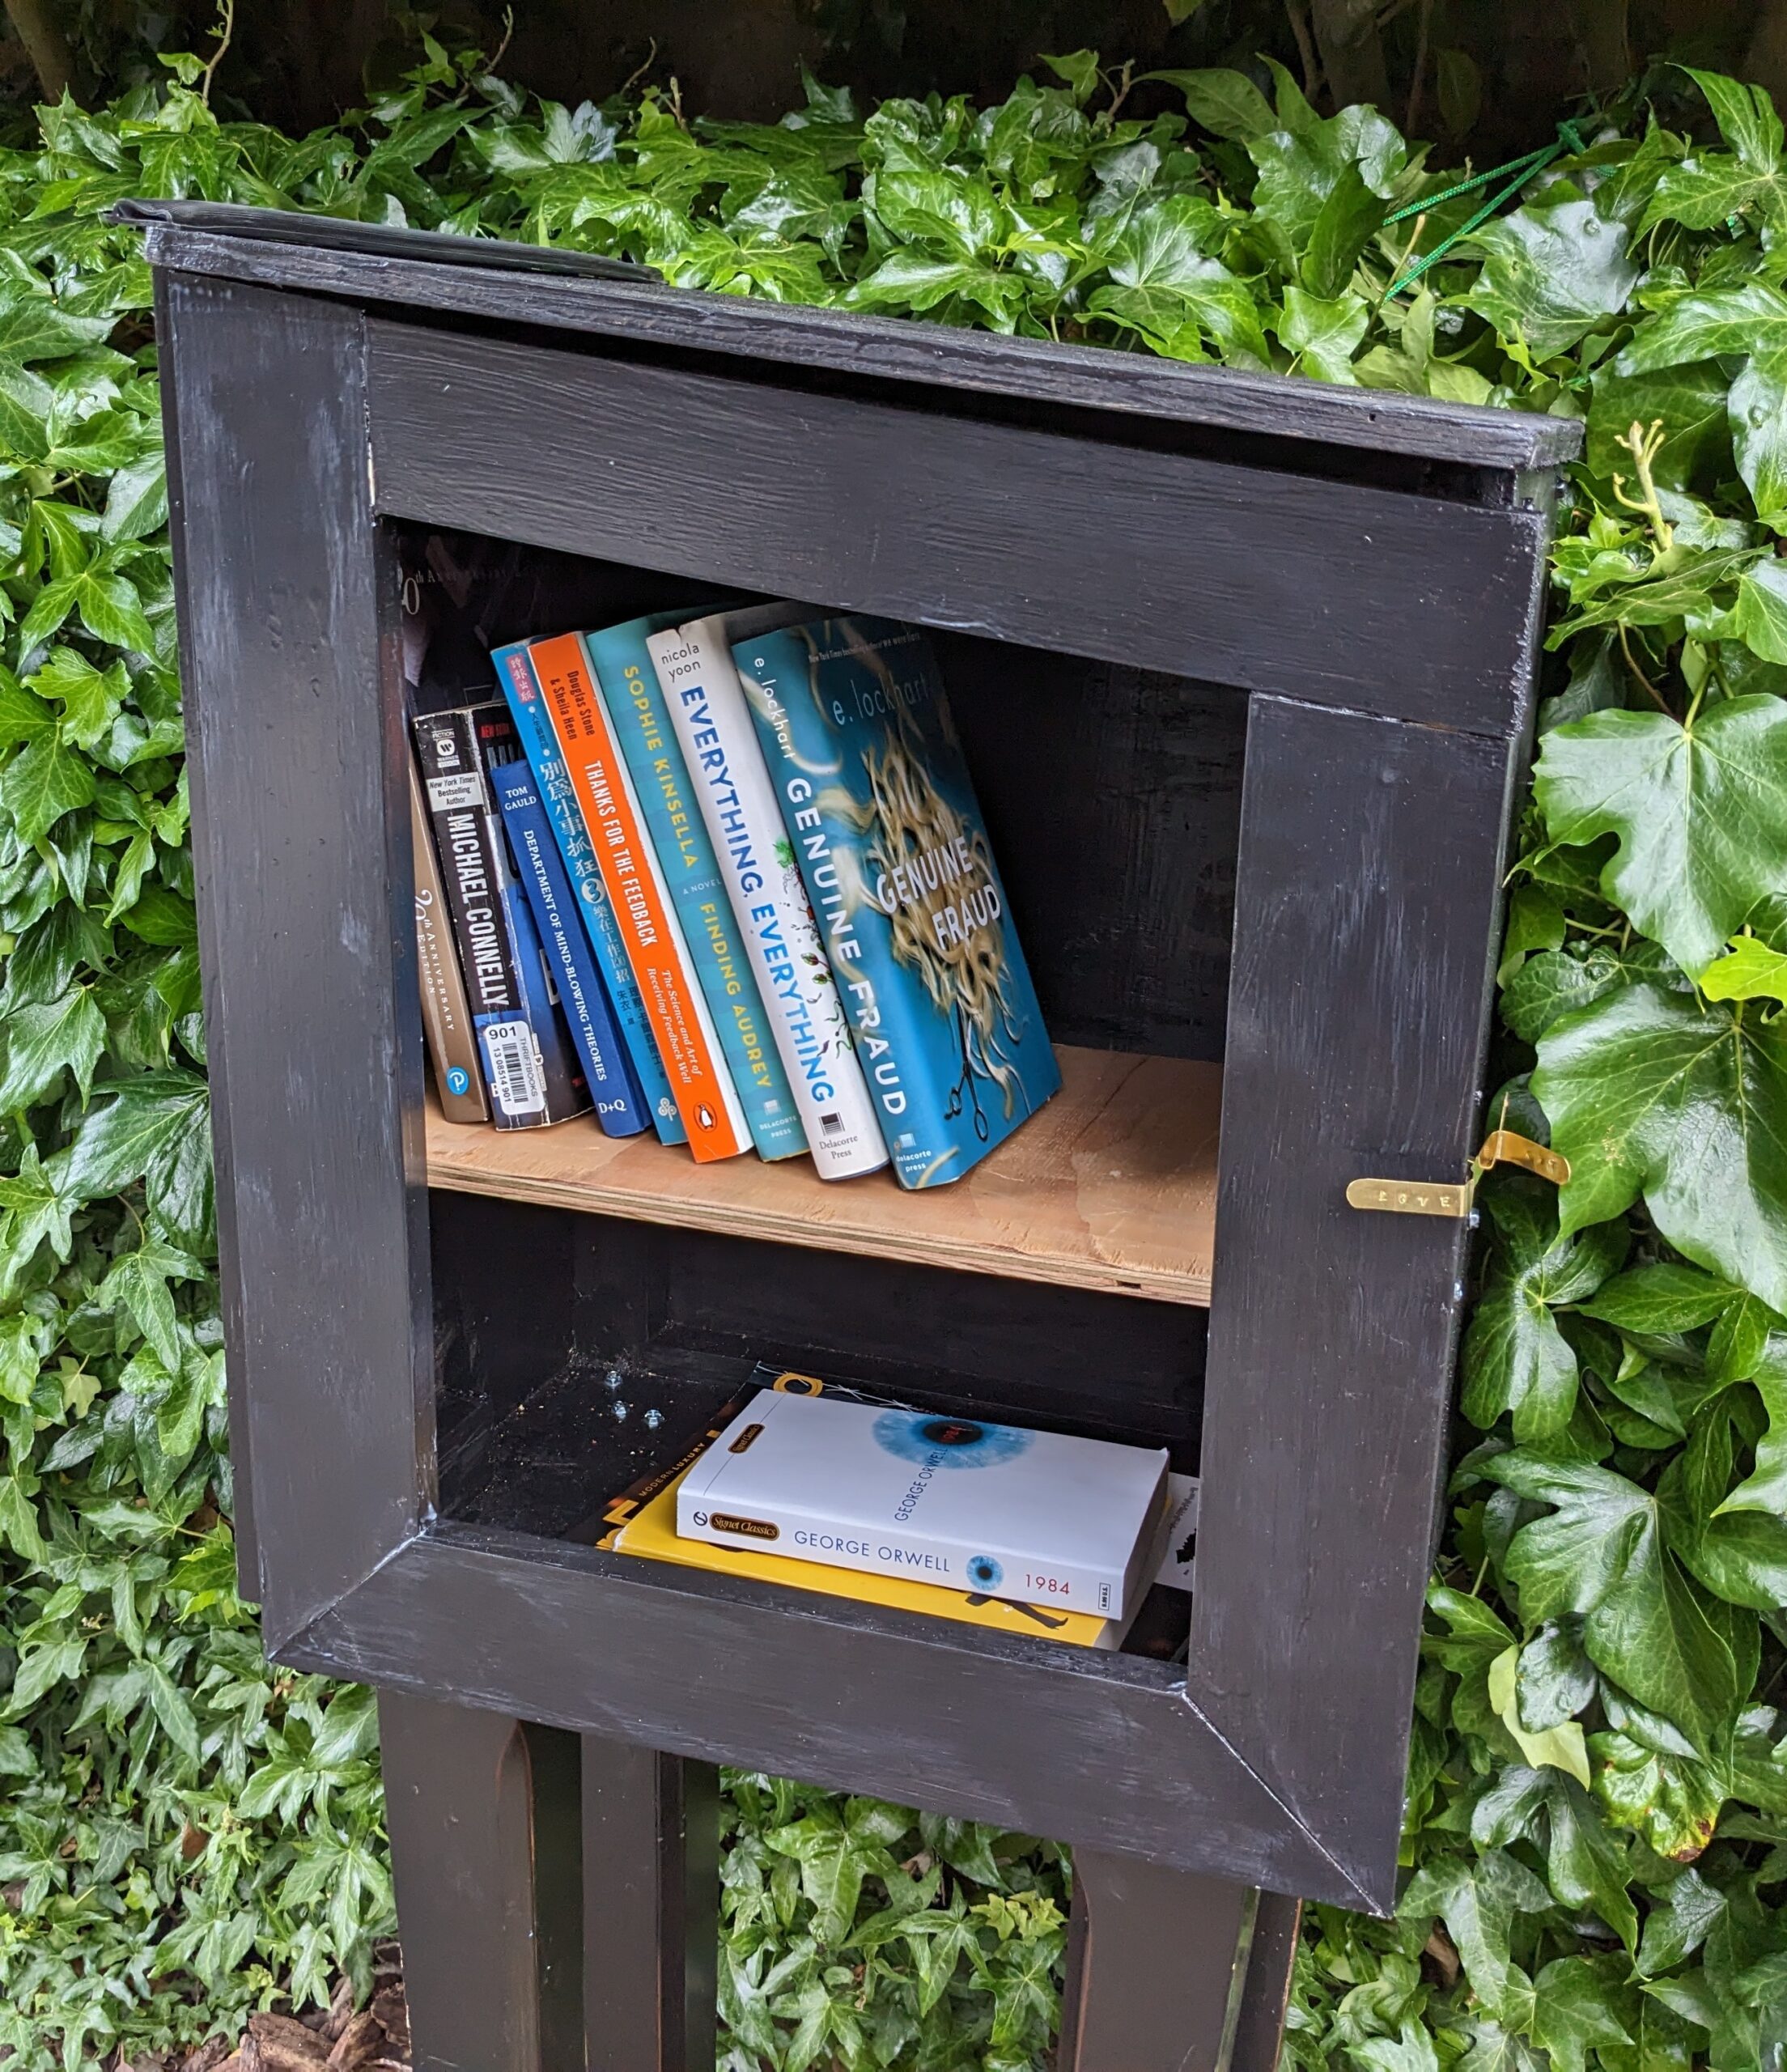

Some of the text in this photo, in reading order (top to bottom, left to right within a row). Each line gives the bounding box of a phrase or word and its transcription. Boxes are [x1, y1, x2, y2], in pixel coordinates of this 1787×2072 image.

[660, 643, 700, 666] nicola
[669, 659, 702, 683] yoon
[550, 677, 578, 741] & Sheila Heen
[567, 670, 596, 737] Douglas Stone
[850, 672, 929, 720] lockhart
[432, 731, 455, 740] FICTION
[761, 679, 796, 760] lockhart
[430, 775, 476, 789] New York Times
[624, 666, 699, 868] SOPHIE KINSELLA
[438, 786, 472, 798] Bestselling
[446, 796, 466, 805] Author
[504, 796, 537, 811] GAULD
[505, 786, 528, 799] TOM
[584, 760, 659, 948] THANKS FOR THE FEEDBACK
[876, 836, 974, 915] GENUINE
[690, 877, 723, 893] NOVEL
[415, 889, 433, 928] 20th
[447, 813, 510, 1007] MICHAEL CONNELLY
[932, 884, 1001, 950] FRAUD
[417, 934, 435, 995] EDITION
[524, 830, 608, 1081] DEPARTMENT OF MIND-BLOWING THEORIES
[787, 778, 907, 1115] GENUINE FRAUD
[427, 932, 455, 1031] ANNIVERSARY
[699, 904, 773, 1089] FINDING AUDREY
[751, 904, 834, 1102] EVERYTHING
[489, 1025, 517, 1040] 901
[647, 968, 692, 1084] Receiving Feedback Well
[661, 970, 703, 1076] The Science and Art of
[493, 1047, 511, 1102] 13 08514 901
[520, 1037, 538, 1097] THRIFTBOOKS
[598, 1098, 627, 1114] D+Q
[759, 1115, 797, 1132] DELACORTE
[770, 1128, 792, 1138] PRESS
[819, 1135, 858, 1150] Delacorte
[830, 1147, 852, 1159] Press
[896, 1149, 932, 1163] delacorte
[905, 1162, 927, 1174] press
[639, 1442, 706, 1497] MODERN LUXURY
[894, 1447, 949, 1521] GEORGE ORWELL
[714, 1516, 776, 1536] Signet Classics
[793, 1530, 951, 1573] GEORGE ORWELL
[1024, 1573, 1071, 1596] 1984
